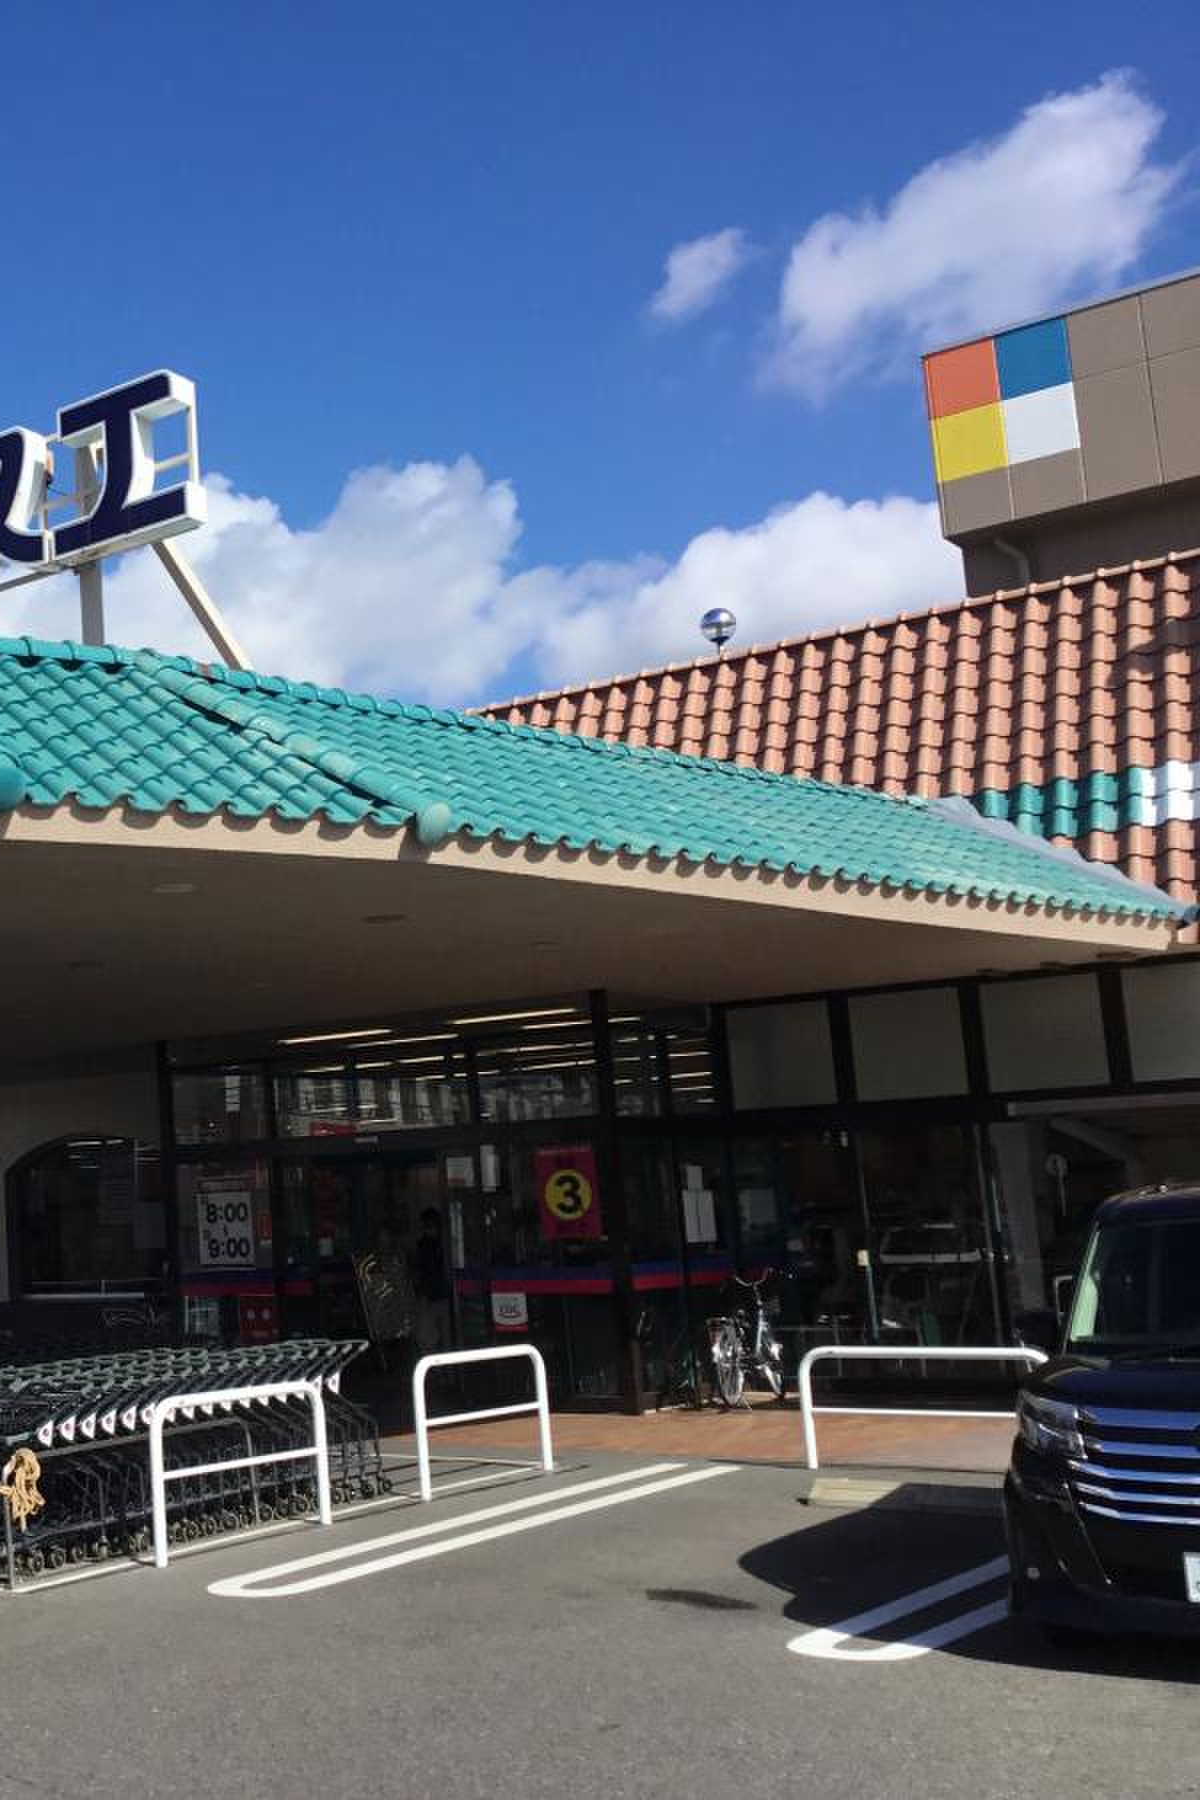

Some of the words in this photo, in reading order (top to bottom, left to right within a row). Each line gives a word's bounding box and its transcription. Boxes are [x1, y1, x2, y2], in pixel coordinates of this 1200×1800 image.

[553, 1175, 582, 1214] 3
[206, 1202, 248, 1223] 8:00
[208, 1237, 250, 1258] 9:00
